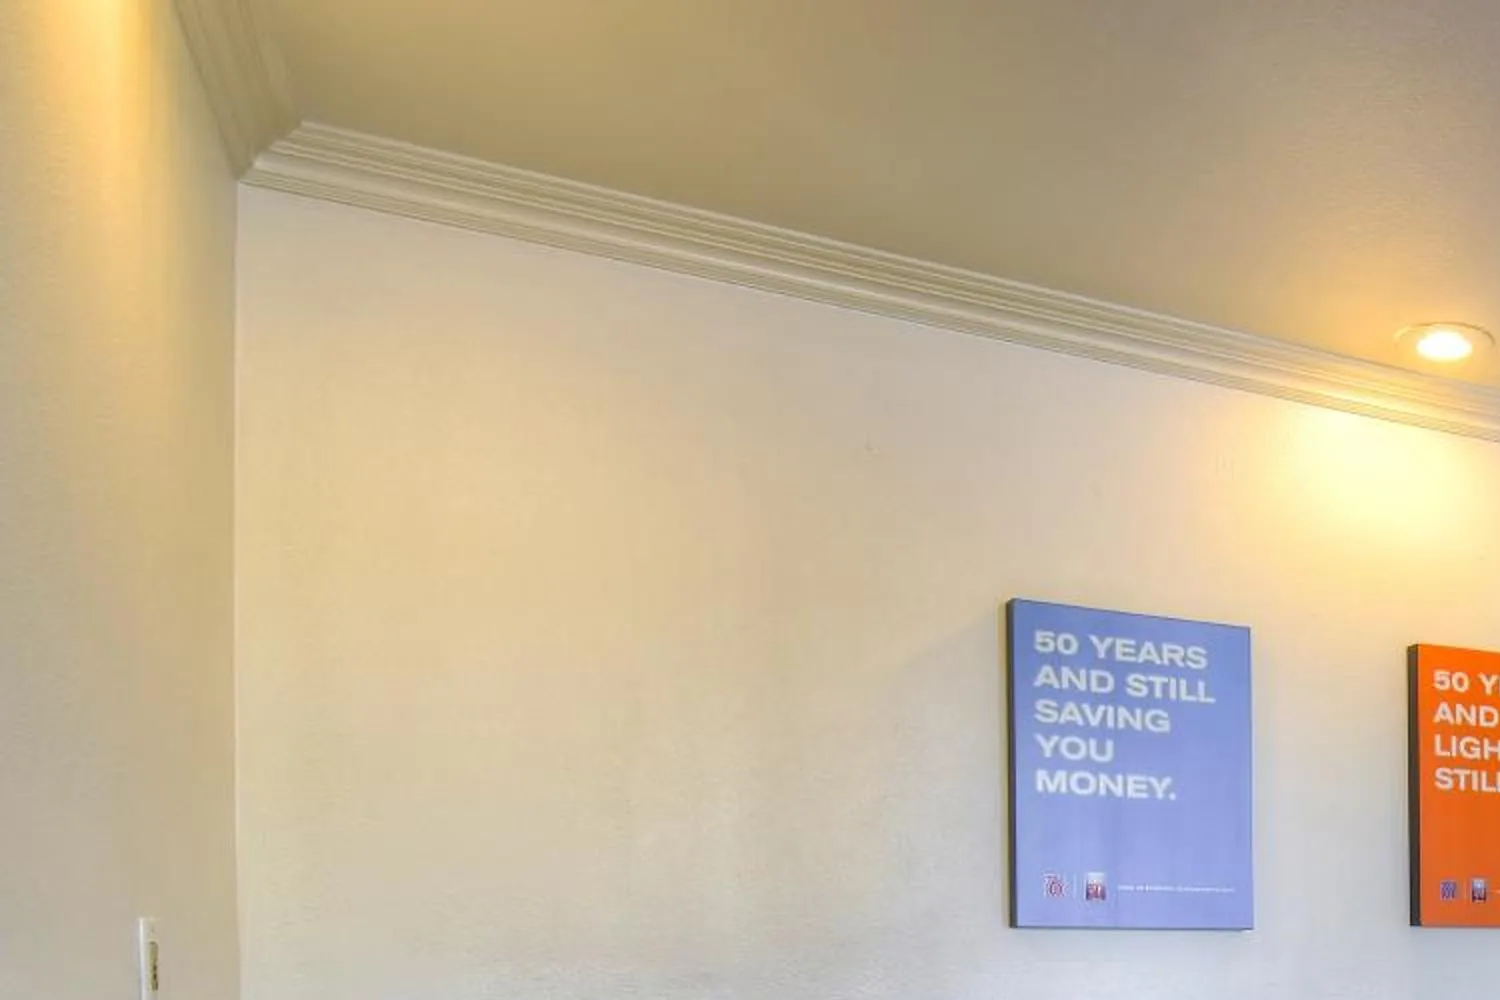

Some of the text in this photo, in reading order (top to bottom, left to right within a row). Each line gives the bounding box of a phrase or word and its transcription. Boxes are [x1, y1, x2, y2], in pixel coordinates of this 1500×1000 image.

[1034, 631, 1208, 669] 50 YEARS
[1034, 666, 1216, 703] AND STILL
[1433, 669, 1470, 693] 50
[1034, 699, 1171, 733] SAVING
[1433, 701, 1499, 728] AND
[1036, 734, 1114, 762] YOU
[1035, 769, 1177, 801] MONEY.
